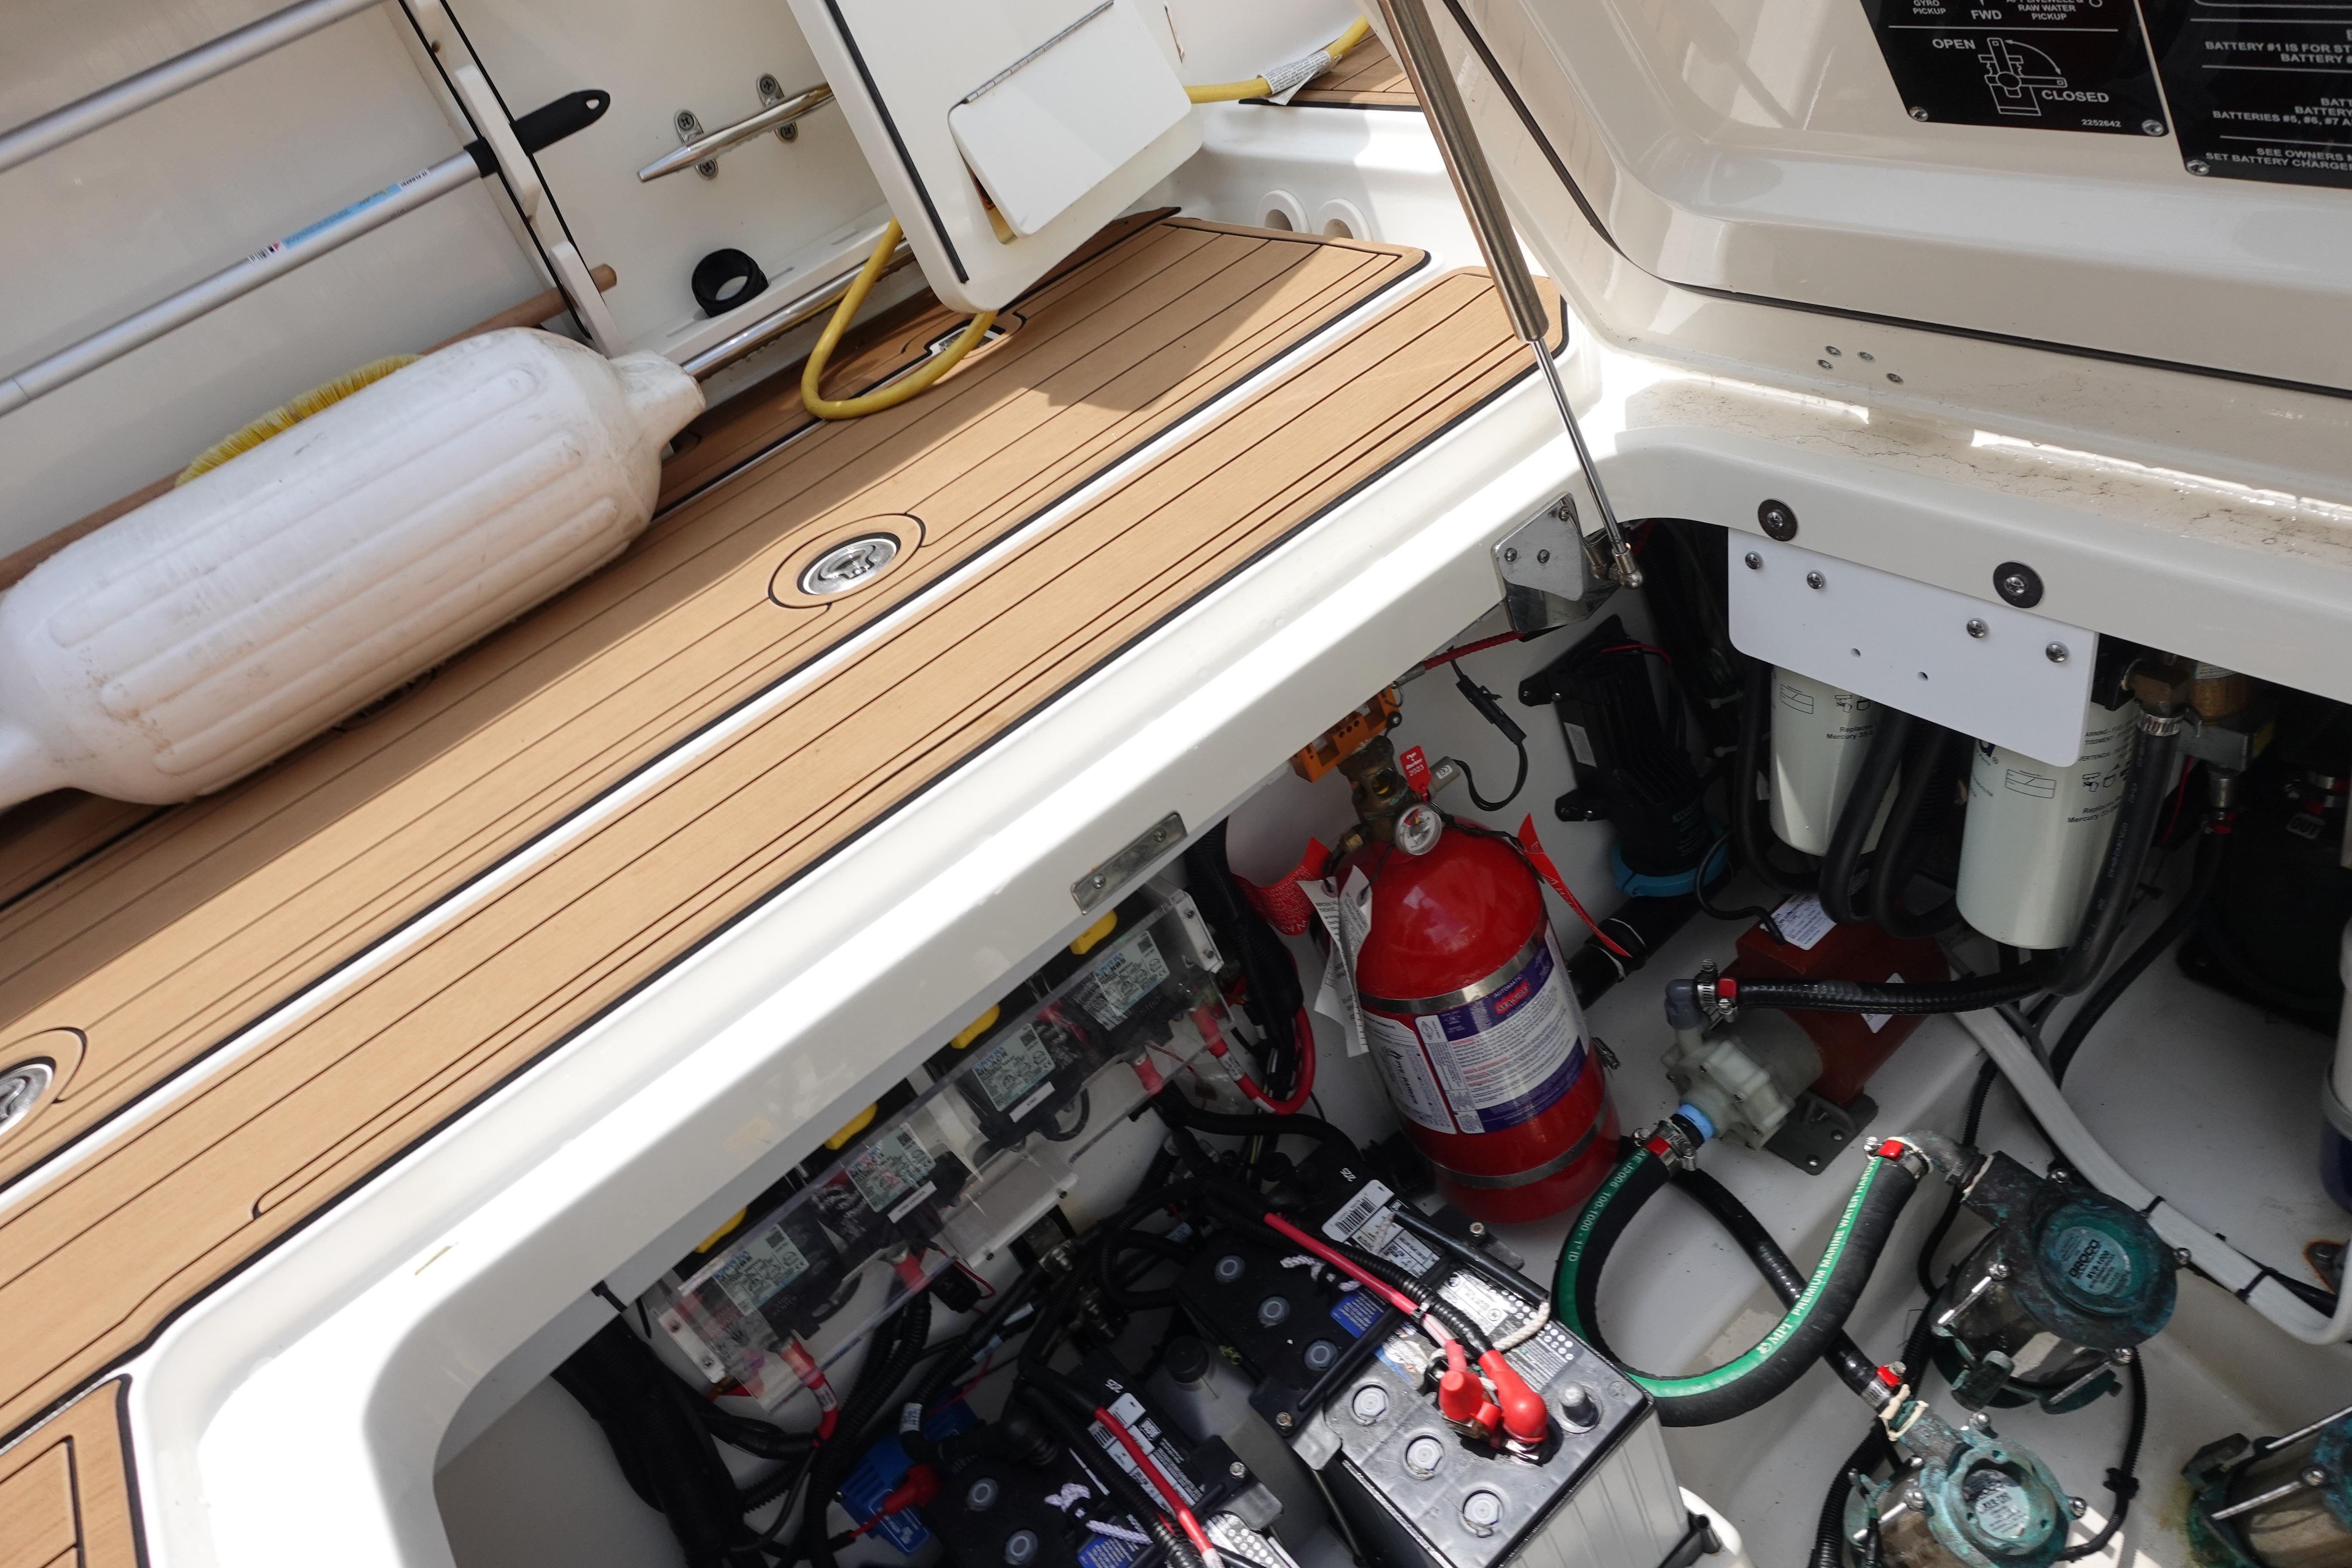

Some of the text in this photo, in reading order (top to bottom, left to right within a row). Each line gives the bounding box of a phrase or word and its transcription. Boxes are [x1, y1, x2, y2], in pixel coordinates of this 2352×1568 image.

[2042, 4, 2076, 12] WATER
[1971, 10, 2002, 20] FWD
[2031, 12, 2067, 21] PICKUP
[1932, 39, 1976, 49] OPEN
[2205, 41, 2264, 51] BATTERY
[2285, 43, 2299, 53] IS
[2301, 44, 2331, 54] FOR
[2280, 53, 2343, 64] BATTERY
[2041, 90, 2110, 103] CLOSED
[2212, 110, 2280, 122] BATTERIES
[2205, 152, 2230, 161] SET
[2231, 154, 2289, 166] BATTERY
[2256, 148, 2283, 157] SEE
[2285, 150, 2343, 162] OWNERS
[2289, 816, 2321, 836] OUT
[1610, 1162, 1634, 1188] J2006
[1580, 1192, 1611, 1231] 100-1000
[1568, 1251, 1580, 1262] ID
[1792, 1270, 1827, 1316] PREMIUM
[1820, 1230, 1846, 1268] MARINE
[1838, 1195, 1861, 1228] WATER
